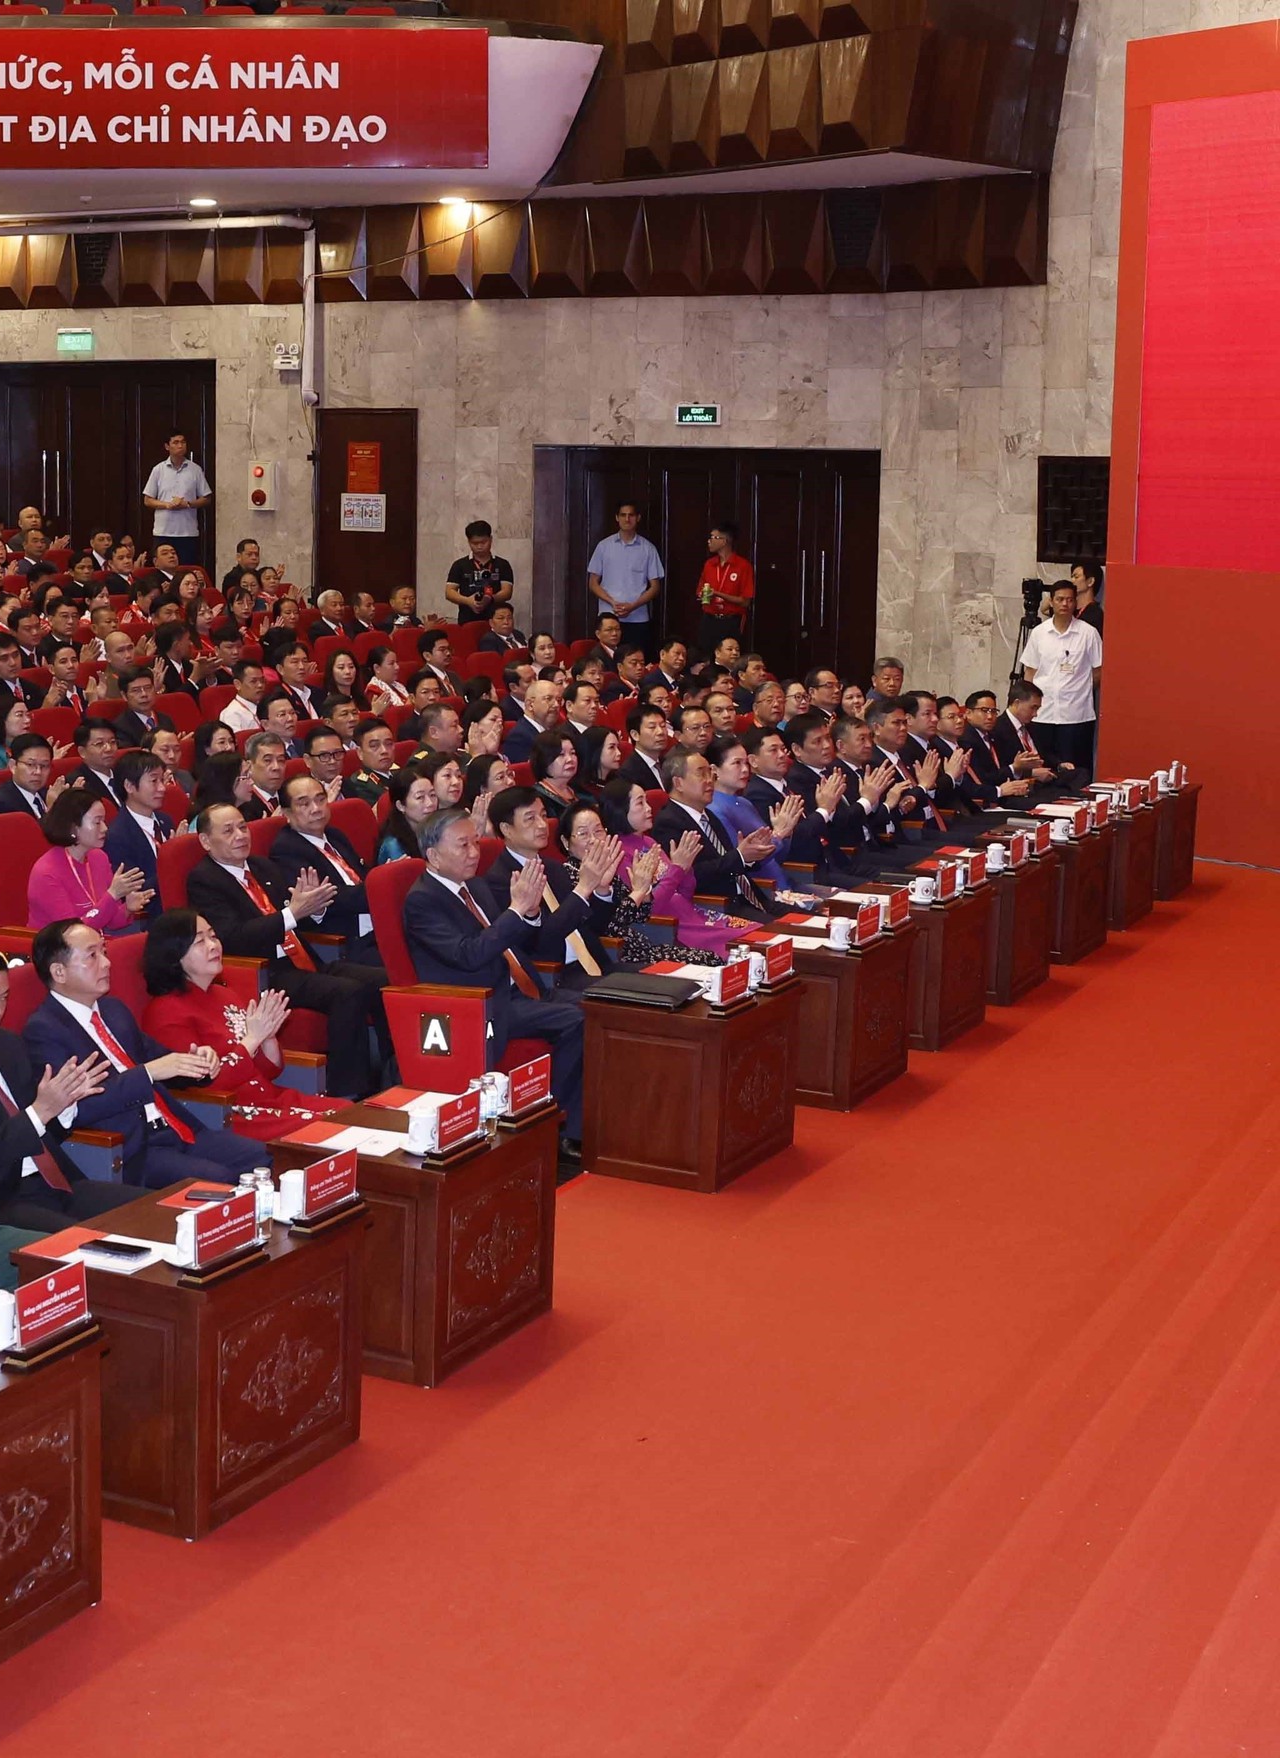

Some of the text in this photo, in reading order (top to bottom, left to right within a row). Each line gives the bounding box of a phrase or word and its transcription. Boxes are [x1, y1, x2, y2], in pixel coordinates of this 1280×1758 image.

[85, 48, 153, 89] MỖI
[166, 53, 218, 89] CÁ
[231, 54, 338, 89] NHÂN
[28, 115, 96, 150] ĐỊA
[107, 104, 169, 143] CHỈ
[182, 107, 290, 142] NHÂN
[302, 115, 386, 150] ĐẠO
[423, 1019, 448, 1050] A
[486, 1021, 494, 1039] A
